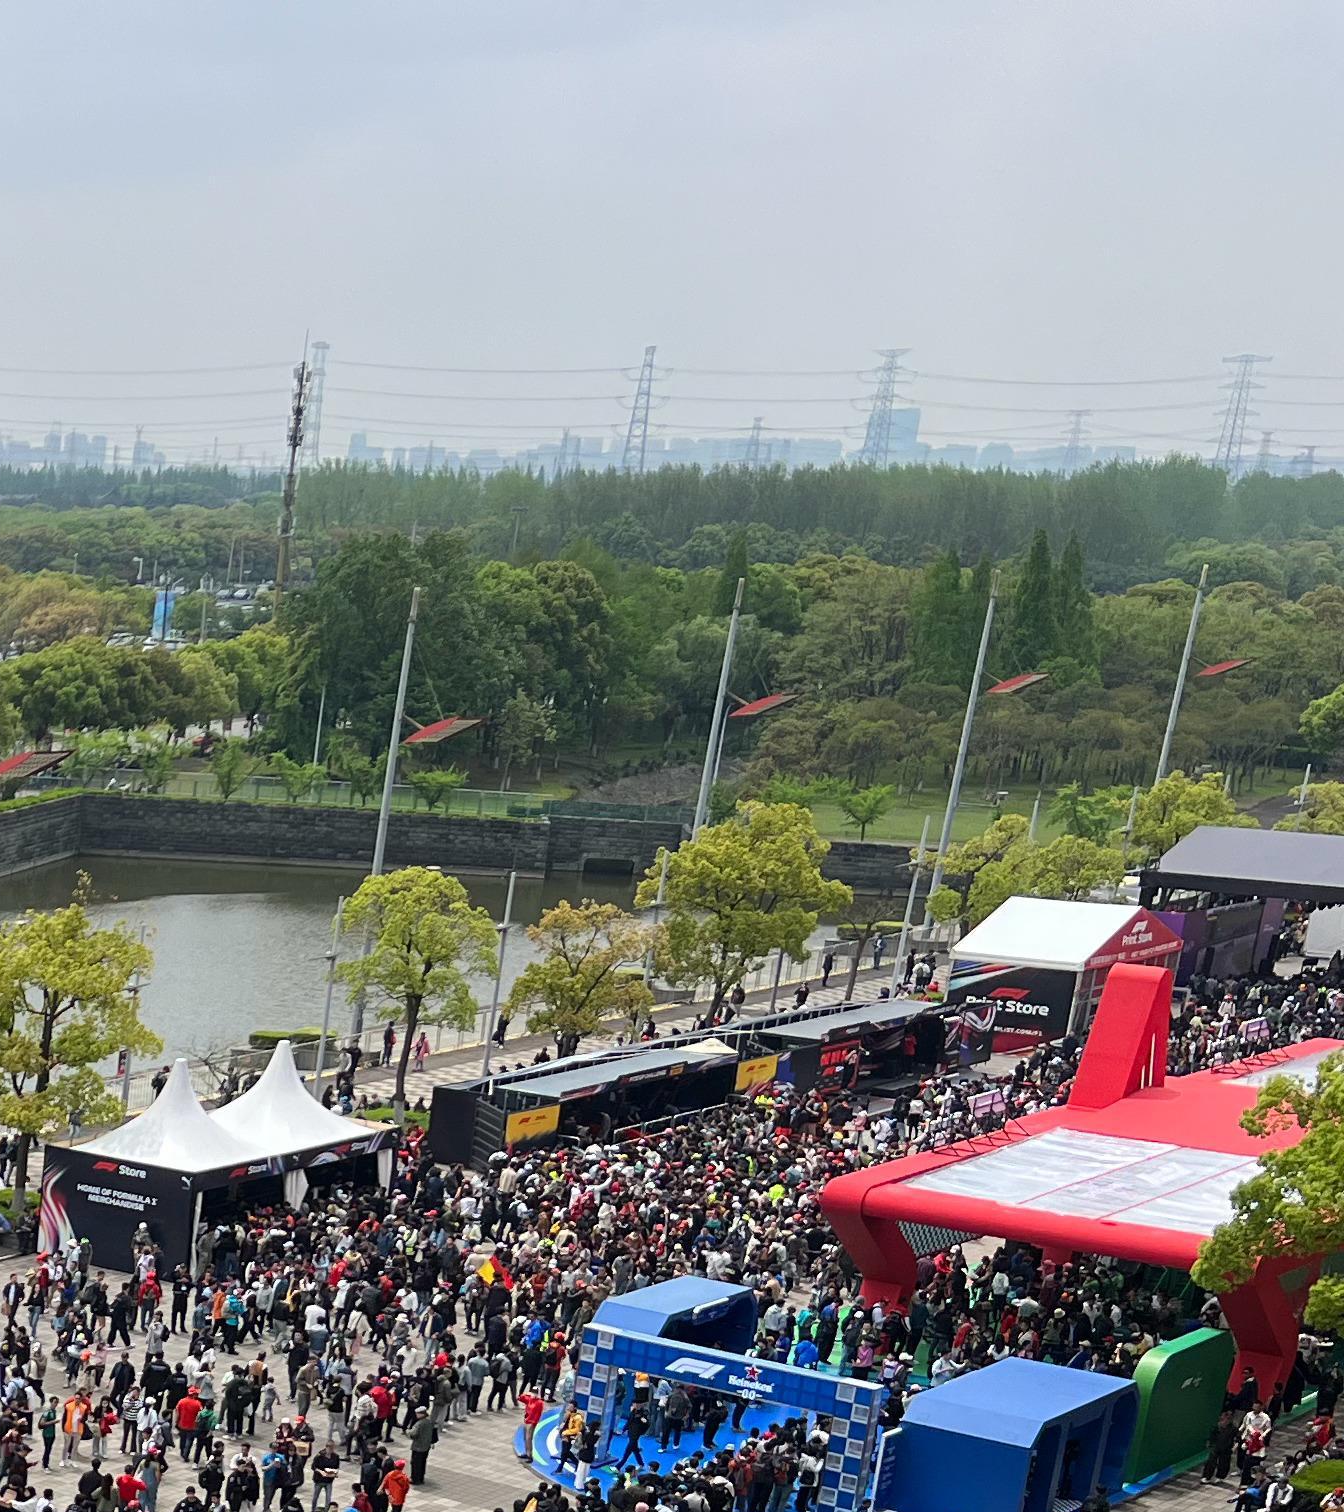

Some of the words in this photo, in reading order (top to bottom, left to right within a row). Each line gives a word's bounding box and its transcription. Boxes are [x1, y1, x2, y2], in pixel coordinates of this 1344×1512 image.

[1004, 1000, 1050, 1017] Store
[118, 1164, 146, 1179] Store
[77, 1183, 101, 1195] HOME
[101, 1188, 113, 1196] OF
[112, 1190, 151, 1205] FORMULA
[87, 1194, 145, 1212] MERCHANDISE
[728, 1374, 774, 1393] Heineken
